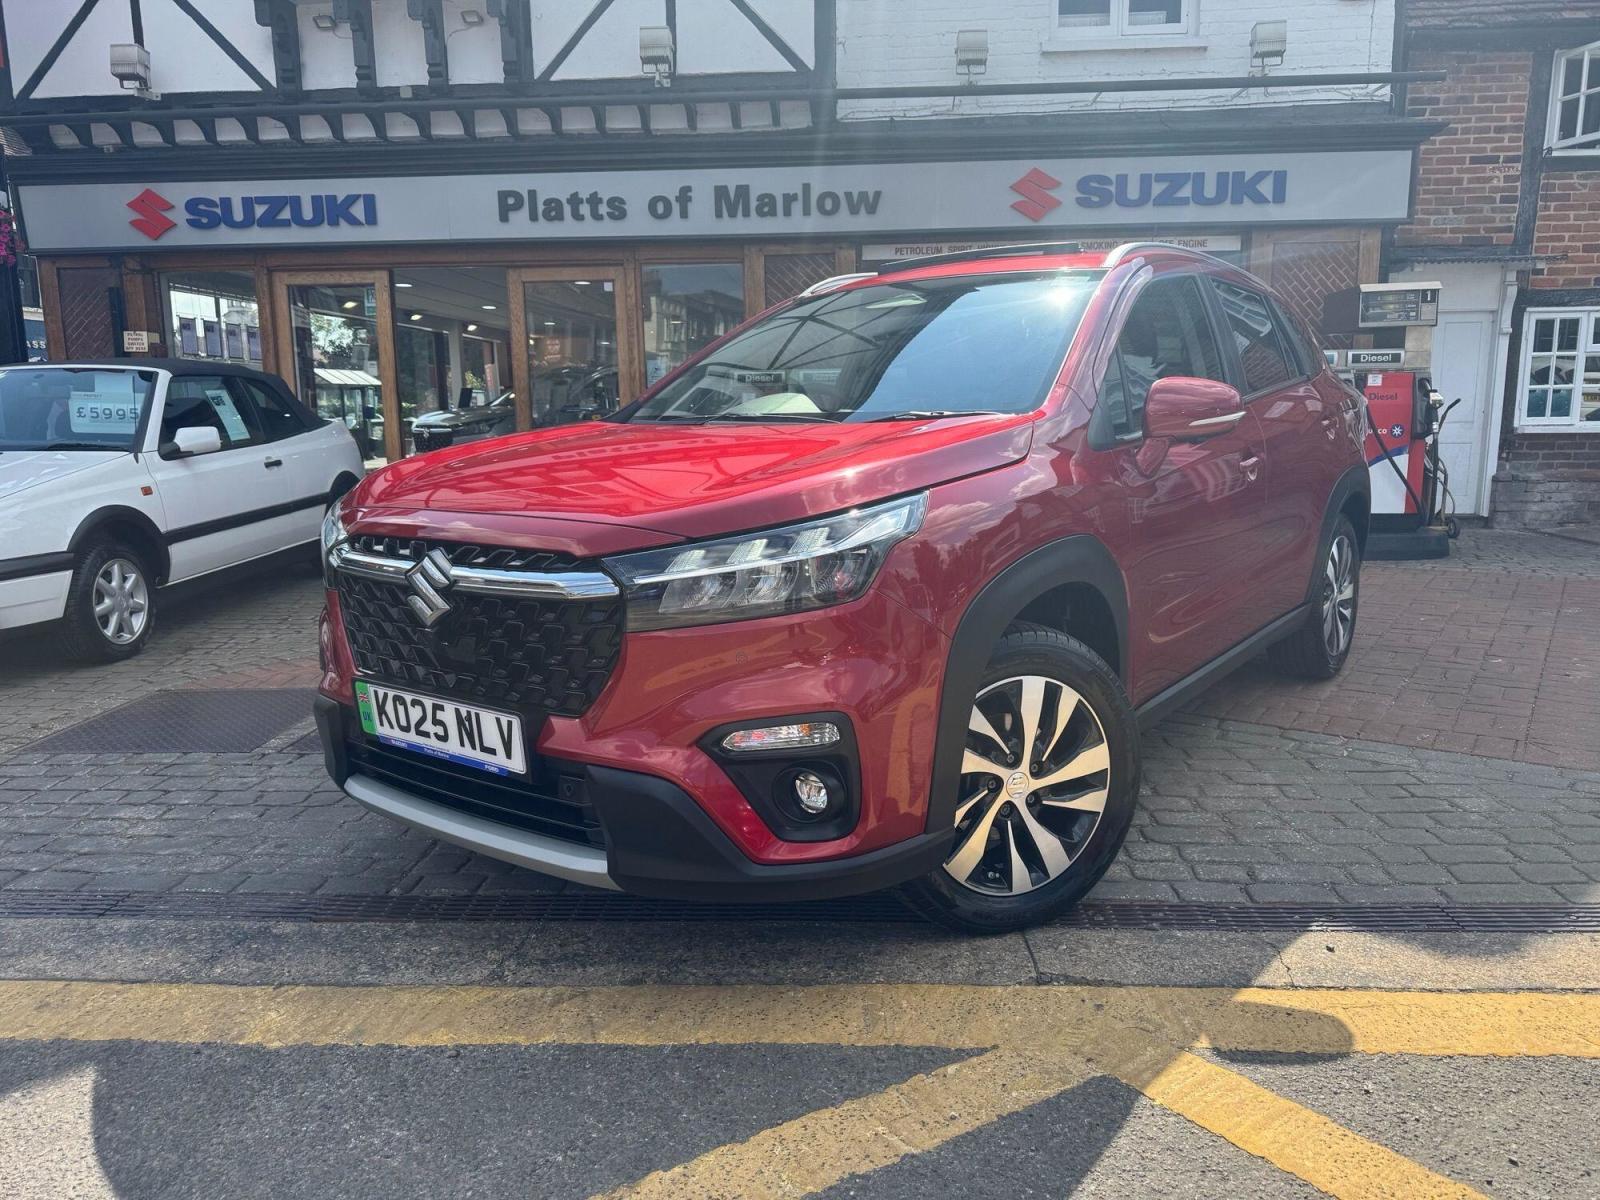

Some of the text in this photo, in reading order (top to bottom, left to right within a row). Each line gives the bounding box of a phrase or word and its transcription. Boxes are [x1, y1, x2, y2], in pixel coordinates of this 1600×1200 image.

[1075, 170, 1287, 209] SUZUKI
[497, 183, 882, 223] Platts of Marlow
[185, 193, 377, 229] SUZUKI
[894, 246, 943, 256] PETROLEUM
[947, 244, 973, 254] SPIRIT
[1080, 241, 1118, 251] SMOKING
[1177, 239, 1208, 249] ENGINE
[1426, 290, 1432, 301] 1
[1360, 354, 1392, 363] Diesel
[745, 374, 775, 383] Diesel
[1369, 392, 1398, 401] Diesel
[76, 406, 140, 420] £5995
[362, 711, 372, 722] UK
[454, 707, 513, 760] NLV
